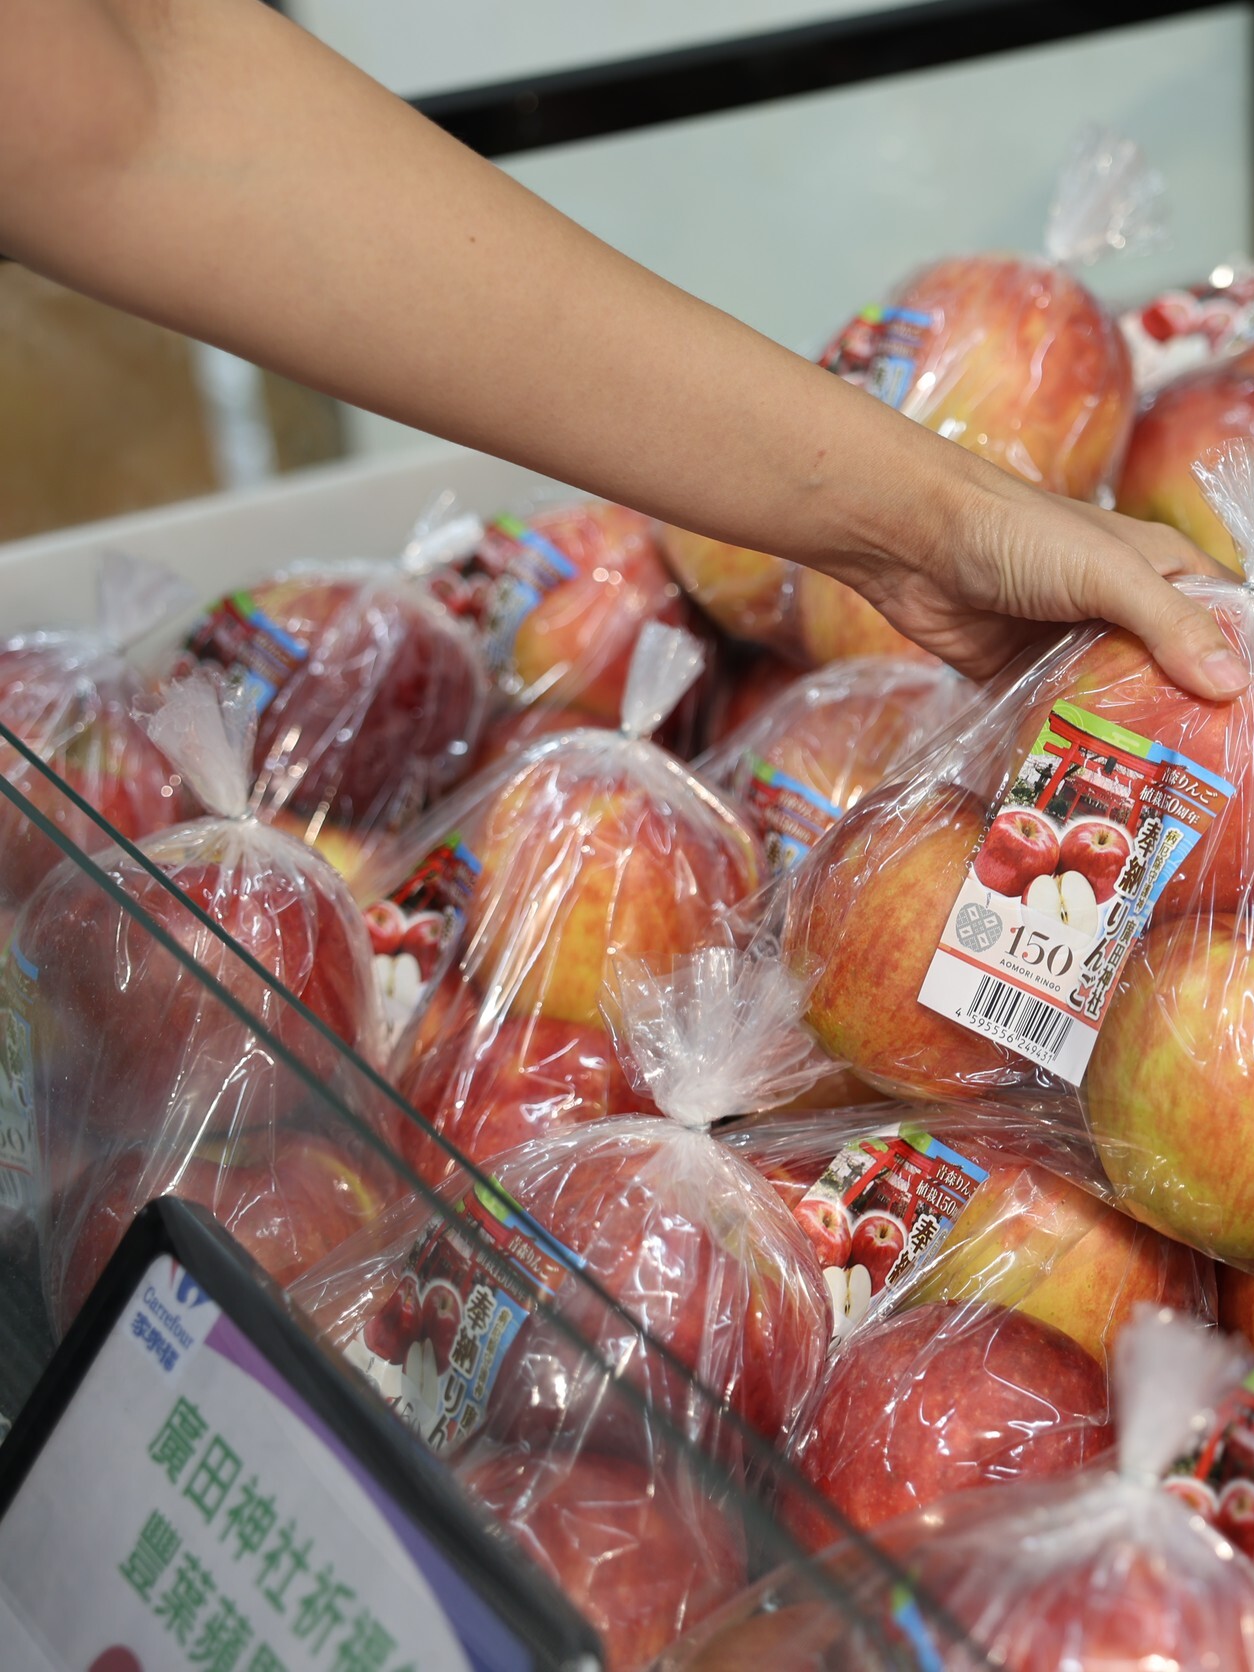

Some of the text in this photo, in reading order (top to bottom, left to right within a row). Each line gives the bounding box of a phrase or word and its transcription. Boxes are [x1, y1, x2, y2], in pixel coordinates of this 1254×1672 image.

[999, 958, 1061, 992] AOMORI RINGO
[1004, 925, 1074, 977] 150
[969, 1014, 1014, 1043] 595556
[1017, 1038, 1053, 1064] 249431
[147, 1396, 418, 1672] 廣田神社祈福
